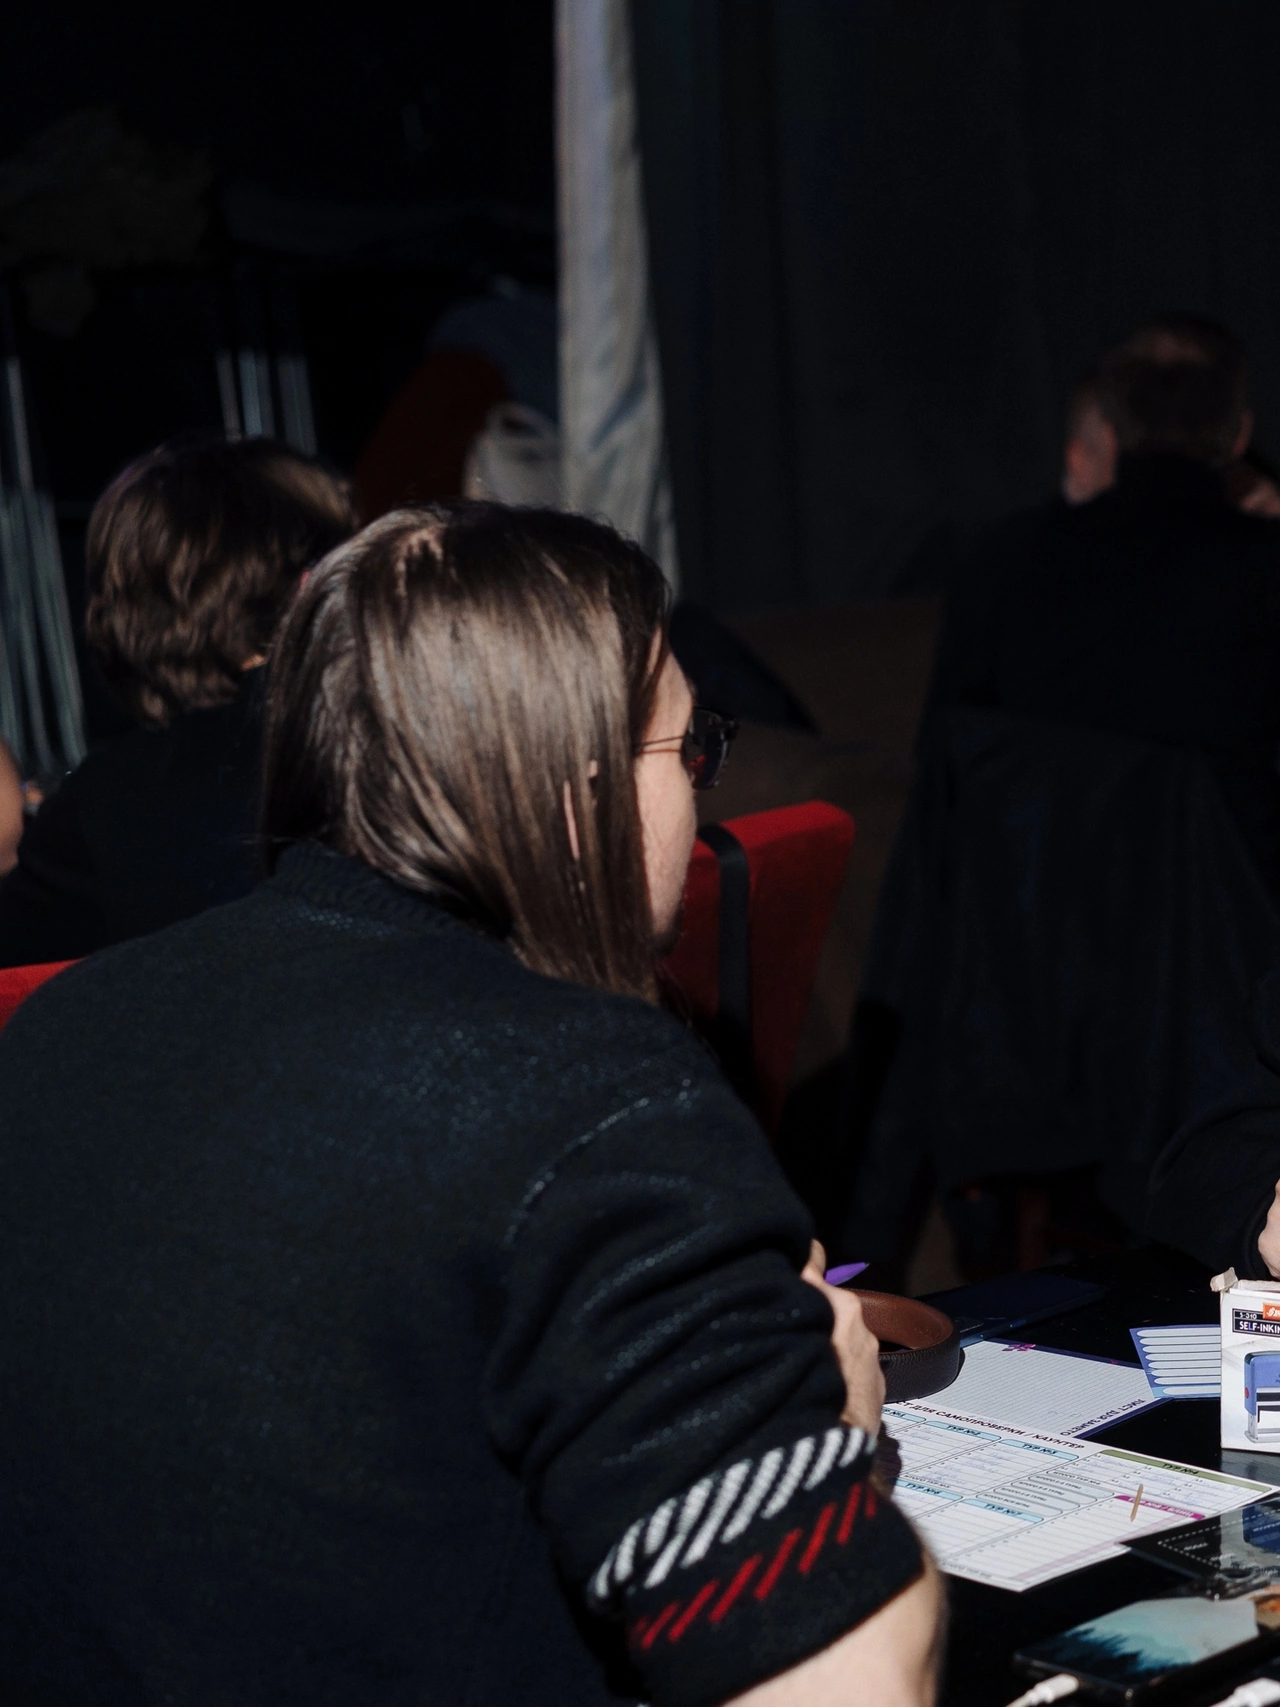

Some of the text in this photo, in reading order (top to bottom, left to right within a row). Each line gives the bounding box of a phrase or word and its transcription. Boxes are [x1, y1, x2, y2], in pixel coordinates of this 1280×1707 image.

[936, 1411, 1026, 1436] САМОПРОВЕРКИ
[1032, 1433, 1085, 1449] КАУНТЕР
[1162, 1463, 1184, 1472] ТУР
